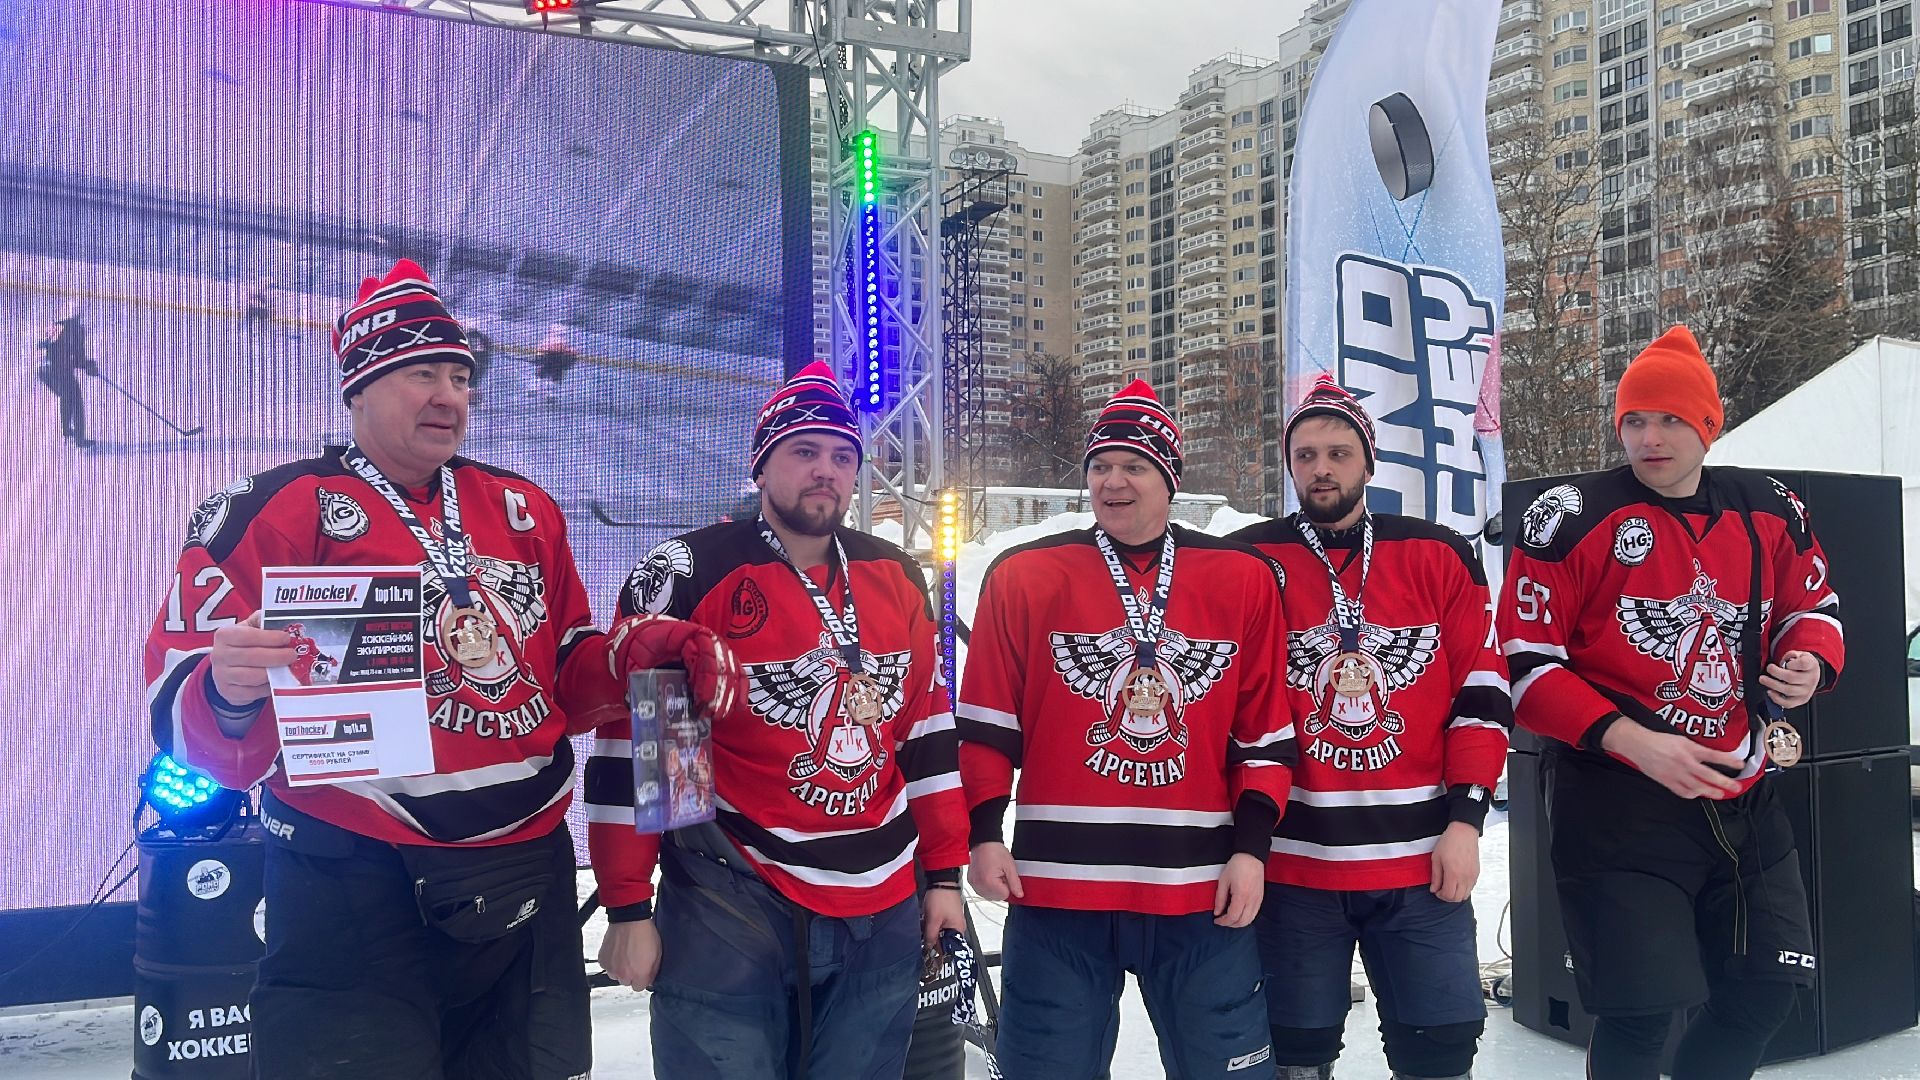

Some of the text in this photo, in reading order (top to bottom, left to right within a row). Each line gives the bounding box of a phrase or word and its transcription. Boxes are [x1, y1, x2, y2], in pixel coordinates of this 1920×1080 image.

[1418, 273, 1491, 537] CKEY
[349, 456, 457, 578] POND HOCKEY
[504, 487, 537, 533] C
[1623, 532, 1648, 551] HG
[1094, 528, 1149, 643] POND HOCKEY
[1155, 532, 1175, 599] HOCKEY
[165, 566, 238, 632] 12
[812, 595, 854, 646] POND
[1332, 580, 1354, 629] POND
[356, 645, 415, 656] ЭКИПИРОВКИ
[361, 631, 414, 644] ХОККЕЙНОЙ
[291, 751, 336, 760] СЕРТИФИКАТ
[326, 757, 352, 765] РУБЛЕЙ
[1304, 734, 1403, 772] АРСЕНАЛ
[789, 770, 879, 817] АРСЕАЛ
[954, 949, 972, 989] 2024
[188, 1009, 205, 1030] Я
